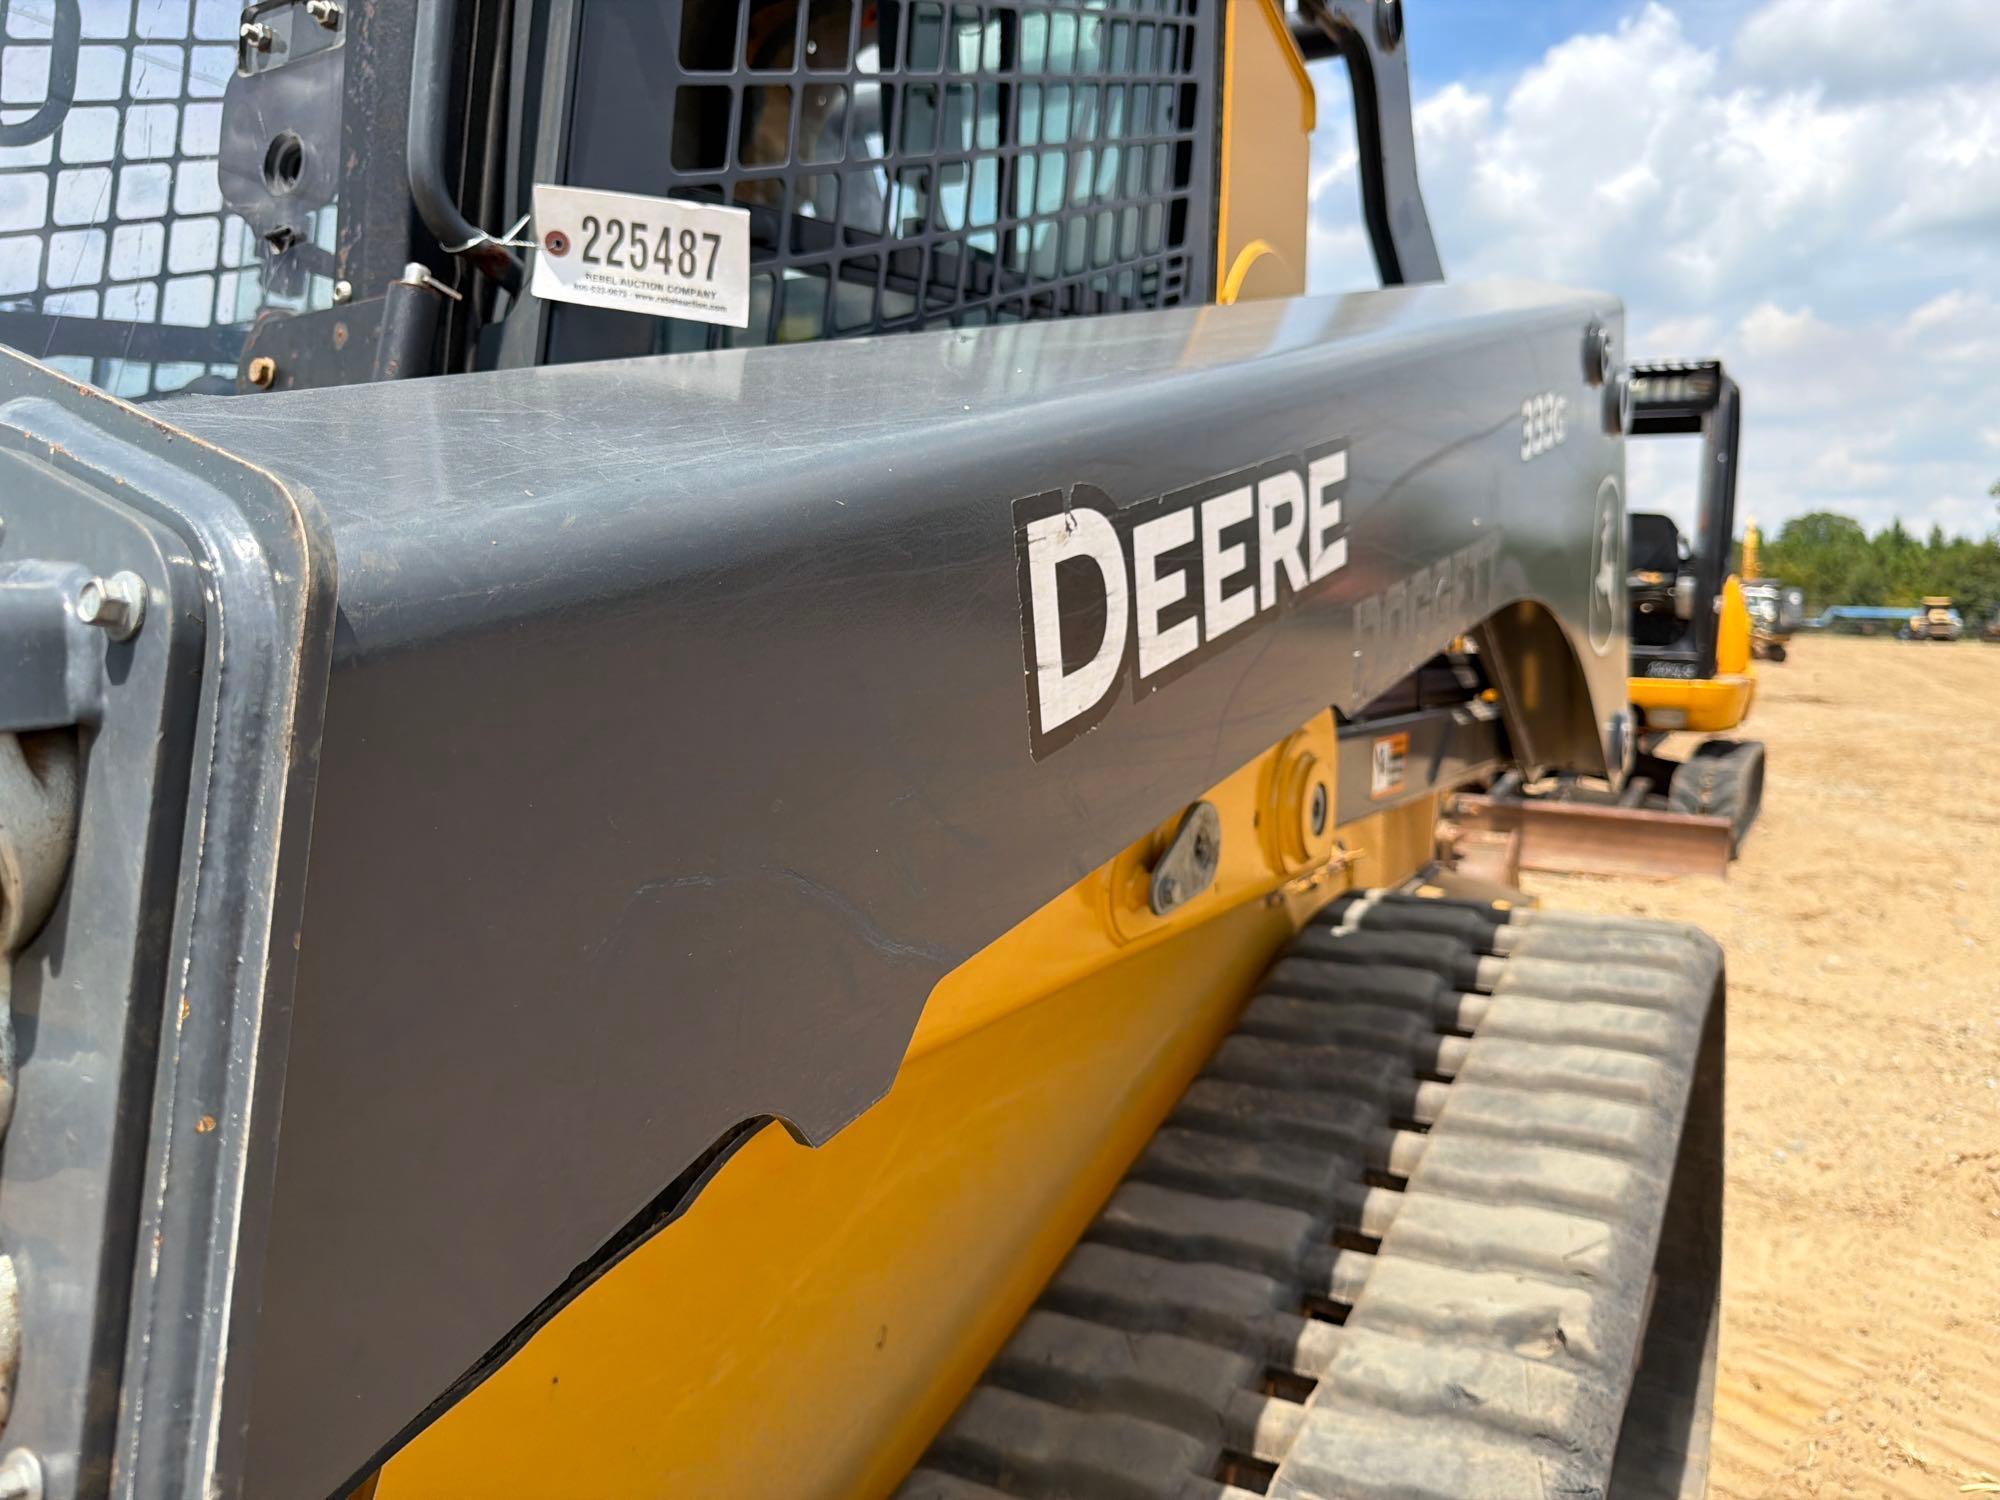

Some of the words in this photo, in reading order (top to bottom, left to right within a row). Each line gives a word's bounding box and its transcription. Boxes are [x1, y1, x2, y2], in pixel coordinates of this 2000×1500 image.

[582, 215, 721, 282] 225487
[620, 276, 664, 291] AUCTION
[667, 284, 717, 299] COMPANY
[1027, 450, 1348, 734] DEERE
